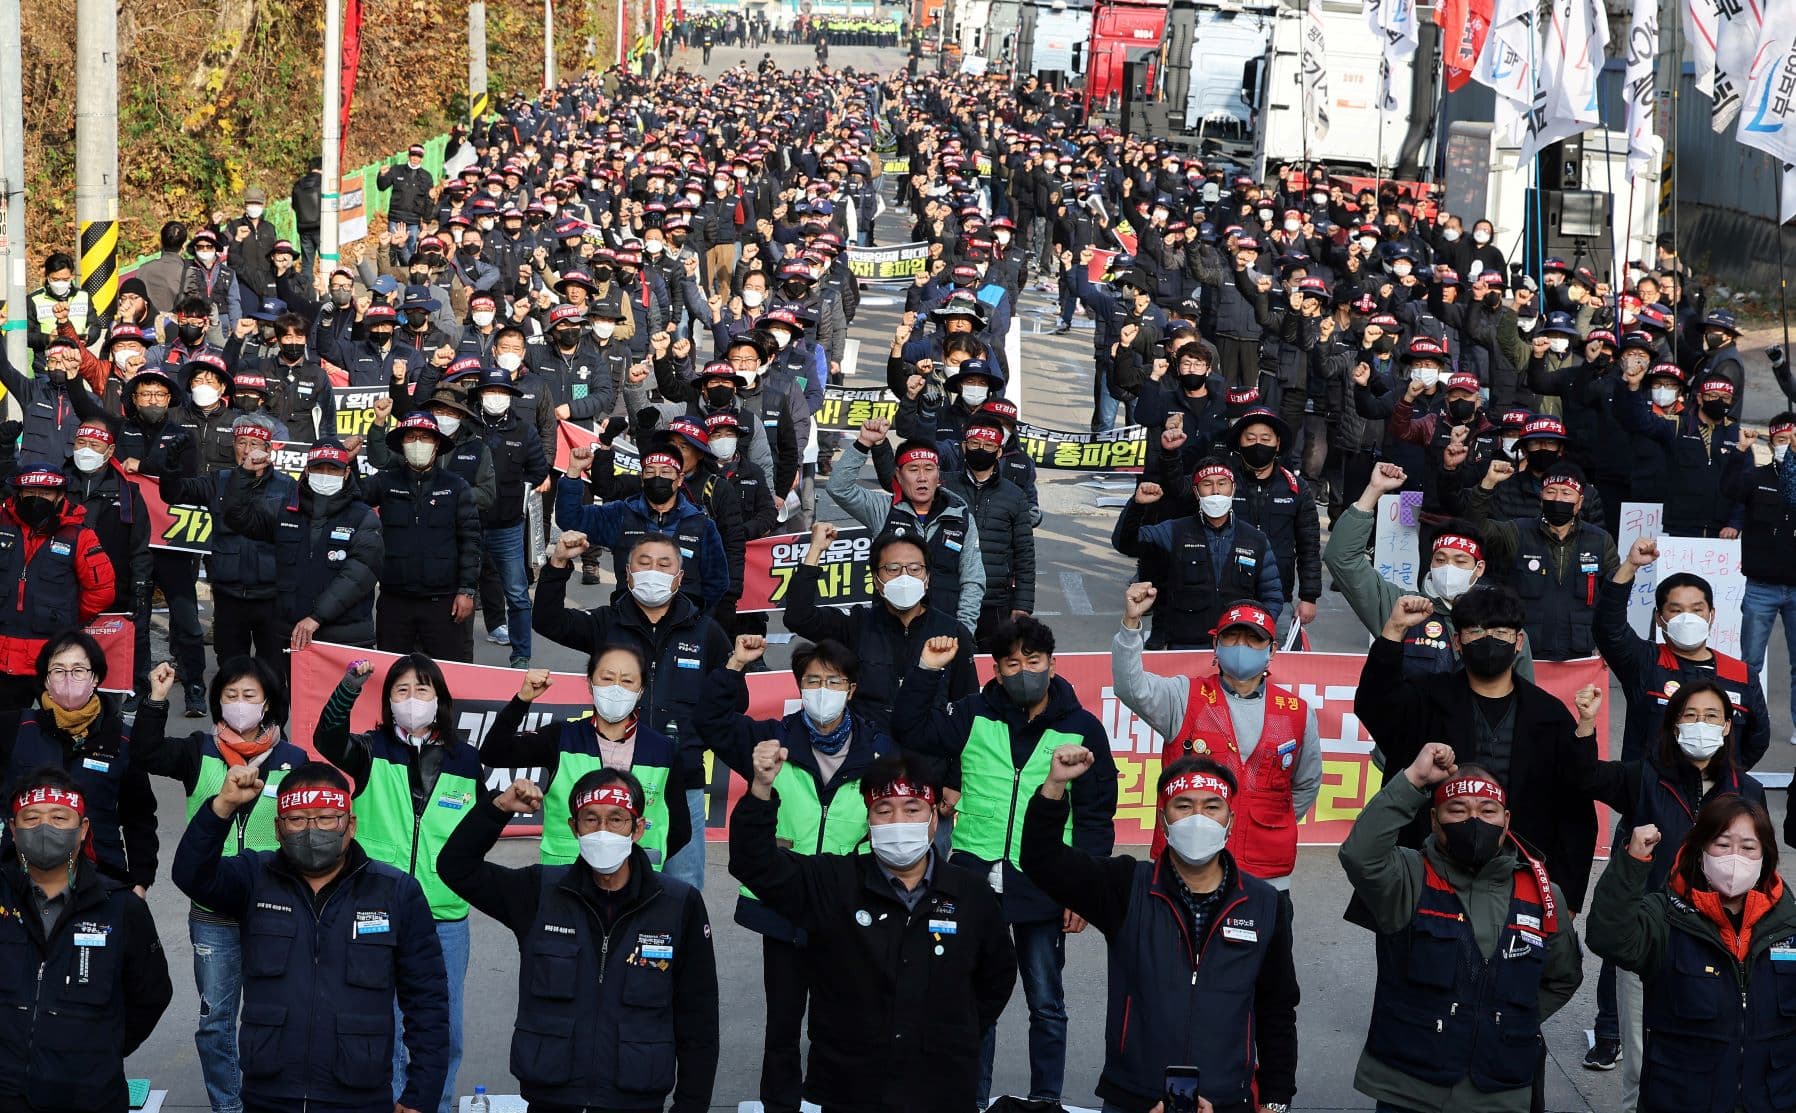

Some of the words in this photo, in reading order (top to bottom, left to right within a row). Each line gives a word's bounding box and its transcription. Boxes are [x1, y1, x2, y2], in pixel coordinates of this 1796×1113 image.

[1054, 440, 1147, 468] 총파업!
[1457, 537, 1477, 553] 투쟁
[1228, 608, 1265, 626] 투쟁
[1274, 695, 1299, 711] 투쟁
[1165, 779, 1189, 796] 가자,
[1191, 774, 1228, 798] 총파업
[1445, 780, 1467, 797] 단결
[281, 791, 301, 809] 단결
[320, 791, 345, 808] 투쟁
